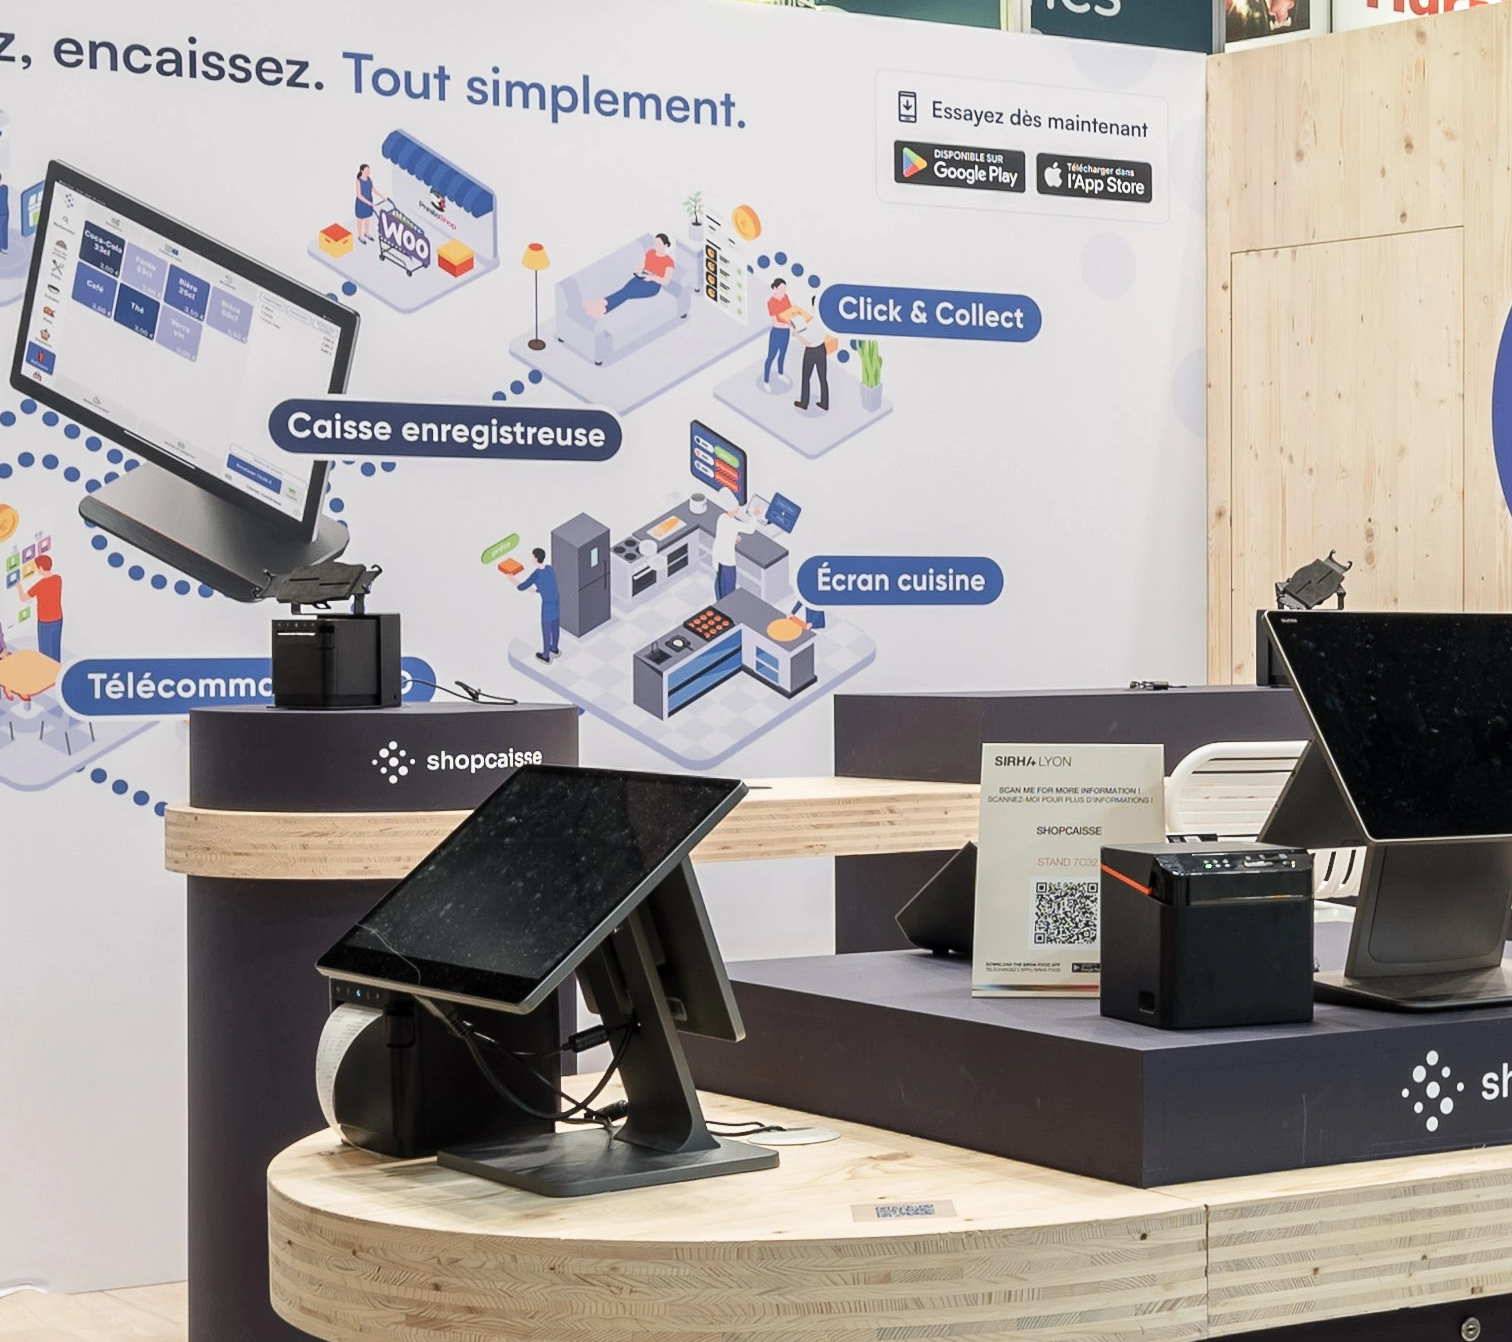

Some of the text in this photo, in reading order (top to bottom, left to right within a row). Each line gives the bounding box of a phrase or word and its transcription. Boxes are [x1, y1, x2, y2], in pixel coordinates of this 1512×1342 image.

[52, 35, 325, 91] encaissez.
[342, 51, 450, 102] Tout
[466, 66, 747, 130] simplement.
[932, 100, 1149, 139] Essayez dès maintenant
[933, 148, 1004, 165] DISPONIBLE SUR
[933, 161, 1018, 188] Google Play
[1066, 162, 1135, 177] Télécharger dans
[1106, 177, 1146, 196] Store
[86, 280, 105, 293] Café
[130, 301, 145, 315] Thé
[838, 295, 1025, 329] Click & Collect
[287, 411, 606, 450] Caisse enregistreuse
[817, 559, 987, 594] Écran cuisine
[425, 747, 542, 774] shopcaisse
[1038, 756, 1072, 767] LYON
[999, 786, 1021, 795] SCAN
[1023, 786, 1036, 794] ME
[1037, 786, 1054, 794] FOR
[1055, 786, 1079, 794] MORE
[1081, 786, 1137, 795] INFORMATION
[1036, 826, 1103, 836] SHOPCAISSE
[1038, 857, 1099, 867] STAND 7C32
